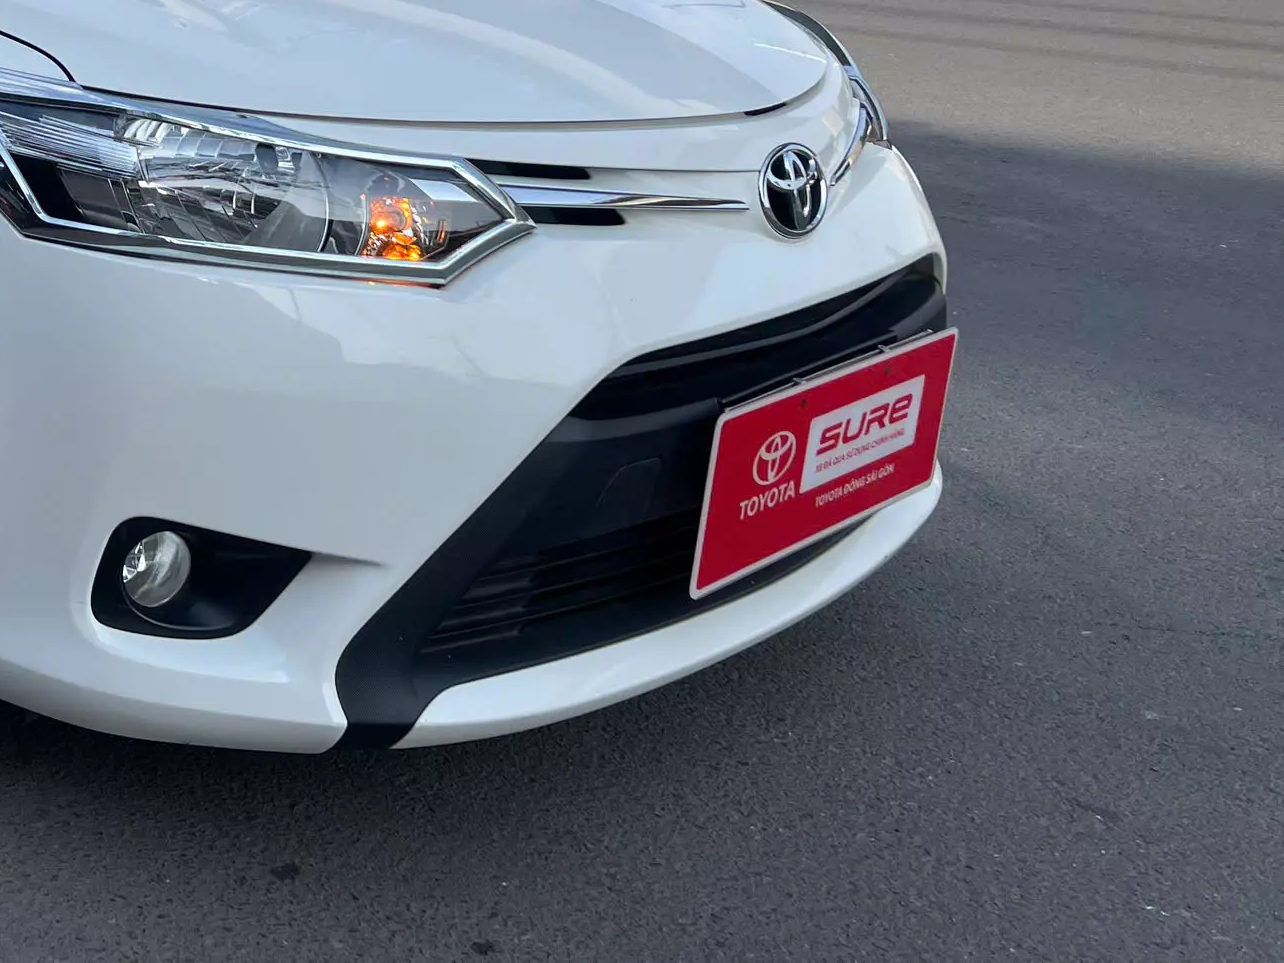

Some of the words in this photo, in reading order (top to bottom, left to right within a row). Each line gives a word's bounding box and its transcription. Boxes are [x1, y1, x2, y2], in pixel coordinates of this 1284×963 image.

[816, 393, 913, 456] SURE
[739, 480, 796, 521] TOYOTA
[815, 485, 843, 508] TOYOTA
